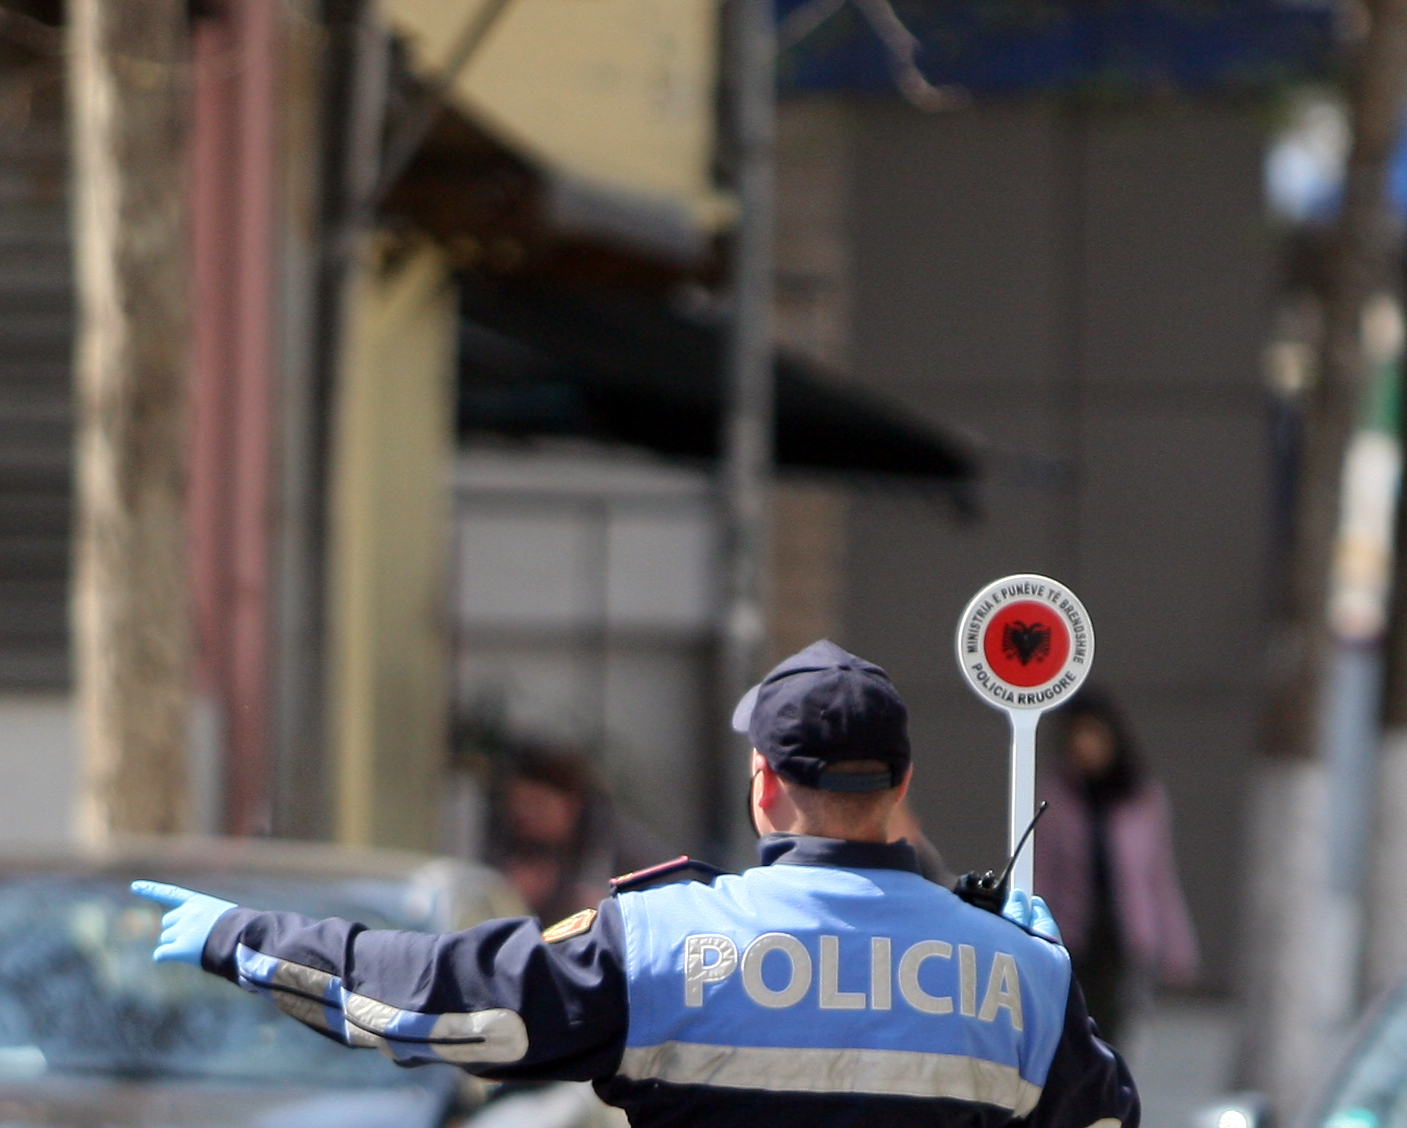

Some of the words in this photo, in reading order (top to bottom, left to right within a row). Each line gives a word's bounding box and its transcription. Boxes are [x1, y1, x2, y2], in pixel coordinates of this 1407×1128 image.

[967, 602, 993, 653] MINISTRIA
[993, 593, 1001, 604] E
[1001, 581, 1046, 600] PUNËVE
[1047, 590, 1062, 604] TË
[1059, 598, 1087, 665] BRENDSHME
[972, 662, 1015, 704] POLICIA
[1017, 670, 1077, 705] RRUGORE
[684, 932, 1024, 1031] POLICIA
